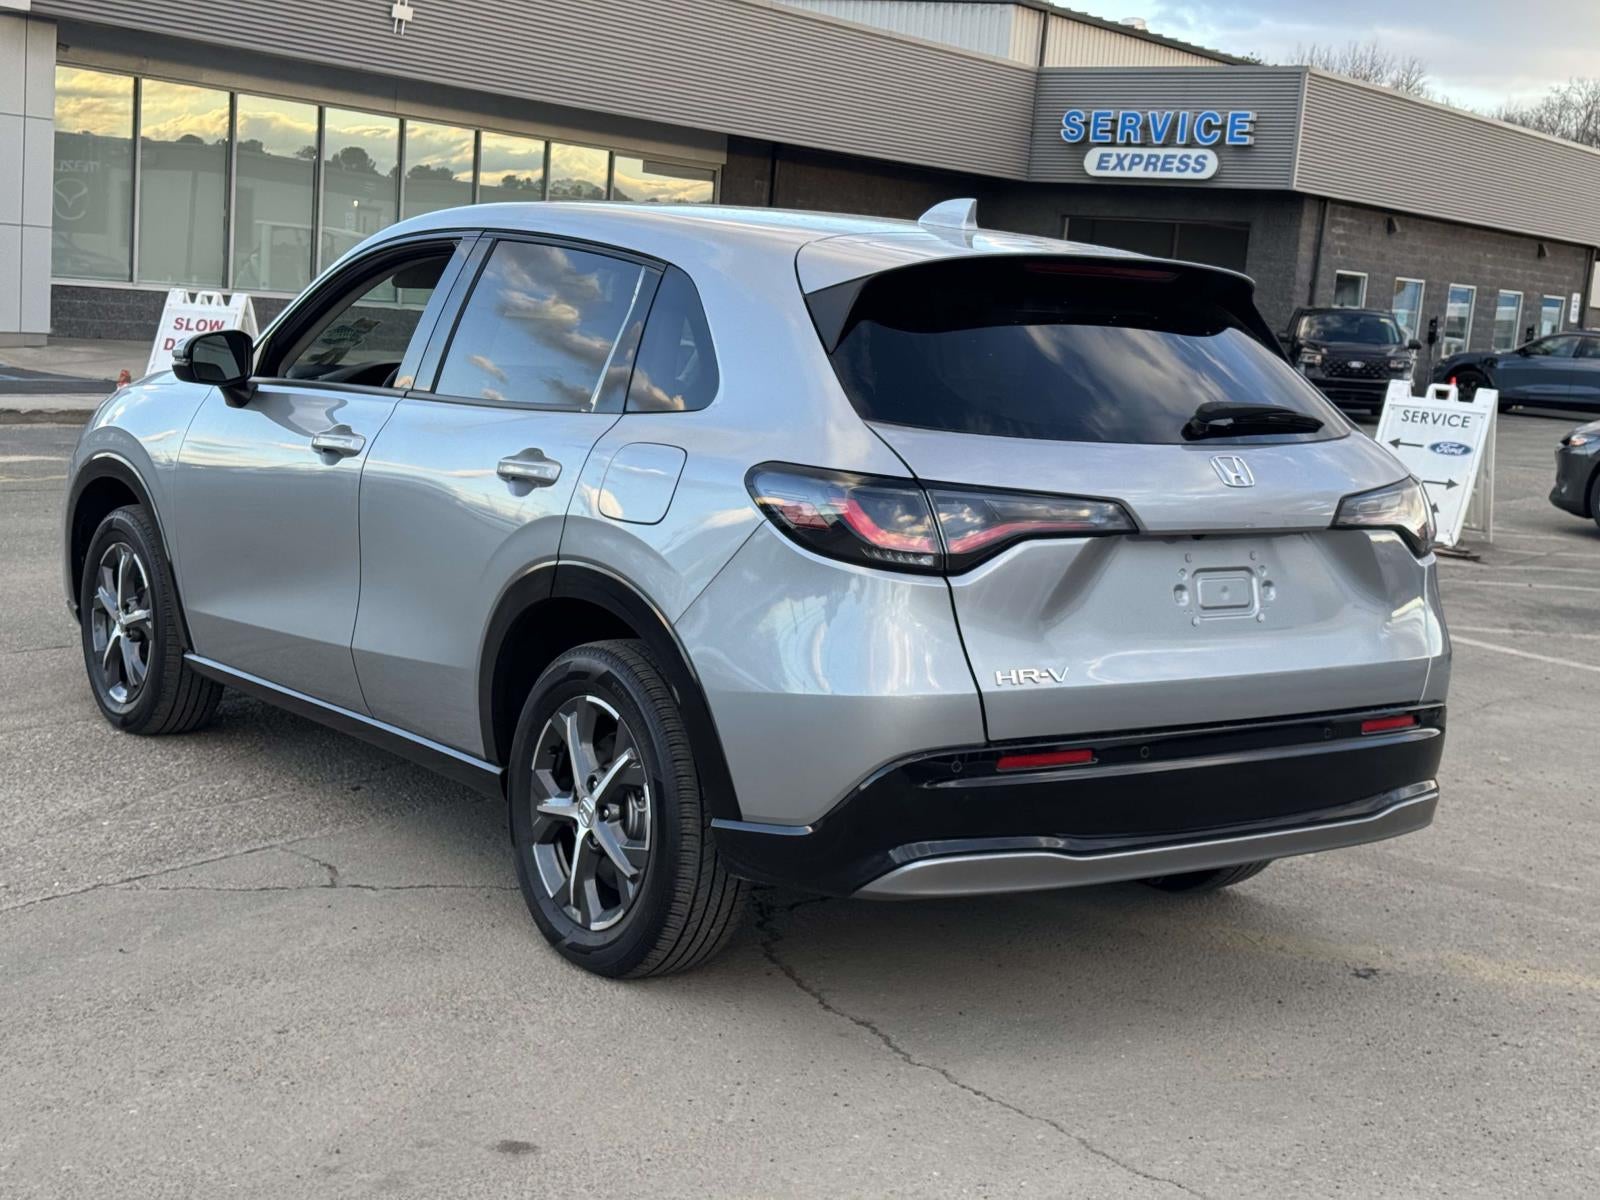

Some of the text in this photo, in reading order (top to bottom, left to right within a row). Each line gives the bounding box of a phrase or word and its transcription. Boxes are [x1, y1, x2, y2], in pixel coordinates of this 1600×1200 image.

[1061, 109, 1256, 146] SERVICE
[1096, 152, 1208, 174] EXPRESS
[173, 317, 225, 332] SLOW
[1401, 409, 1471, 428] SERVICE
[995, 666, 1069, 686] HR-V
